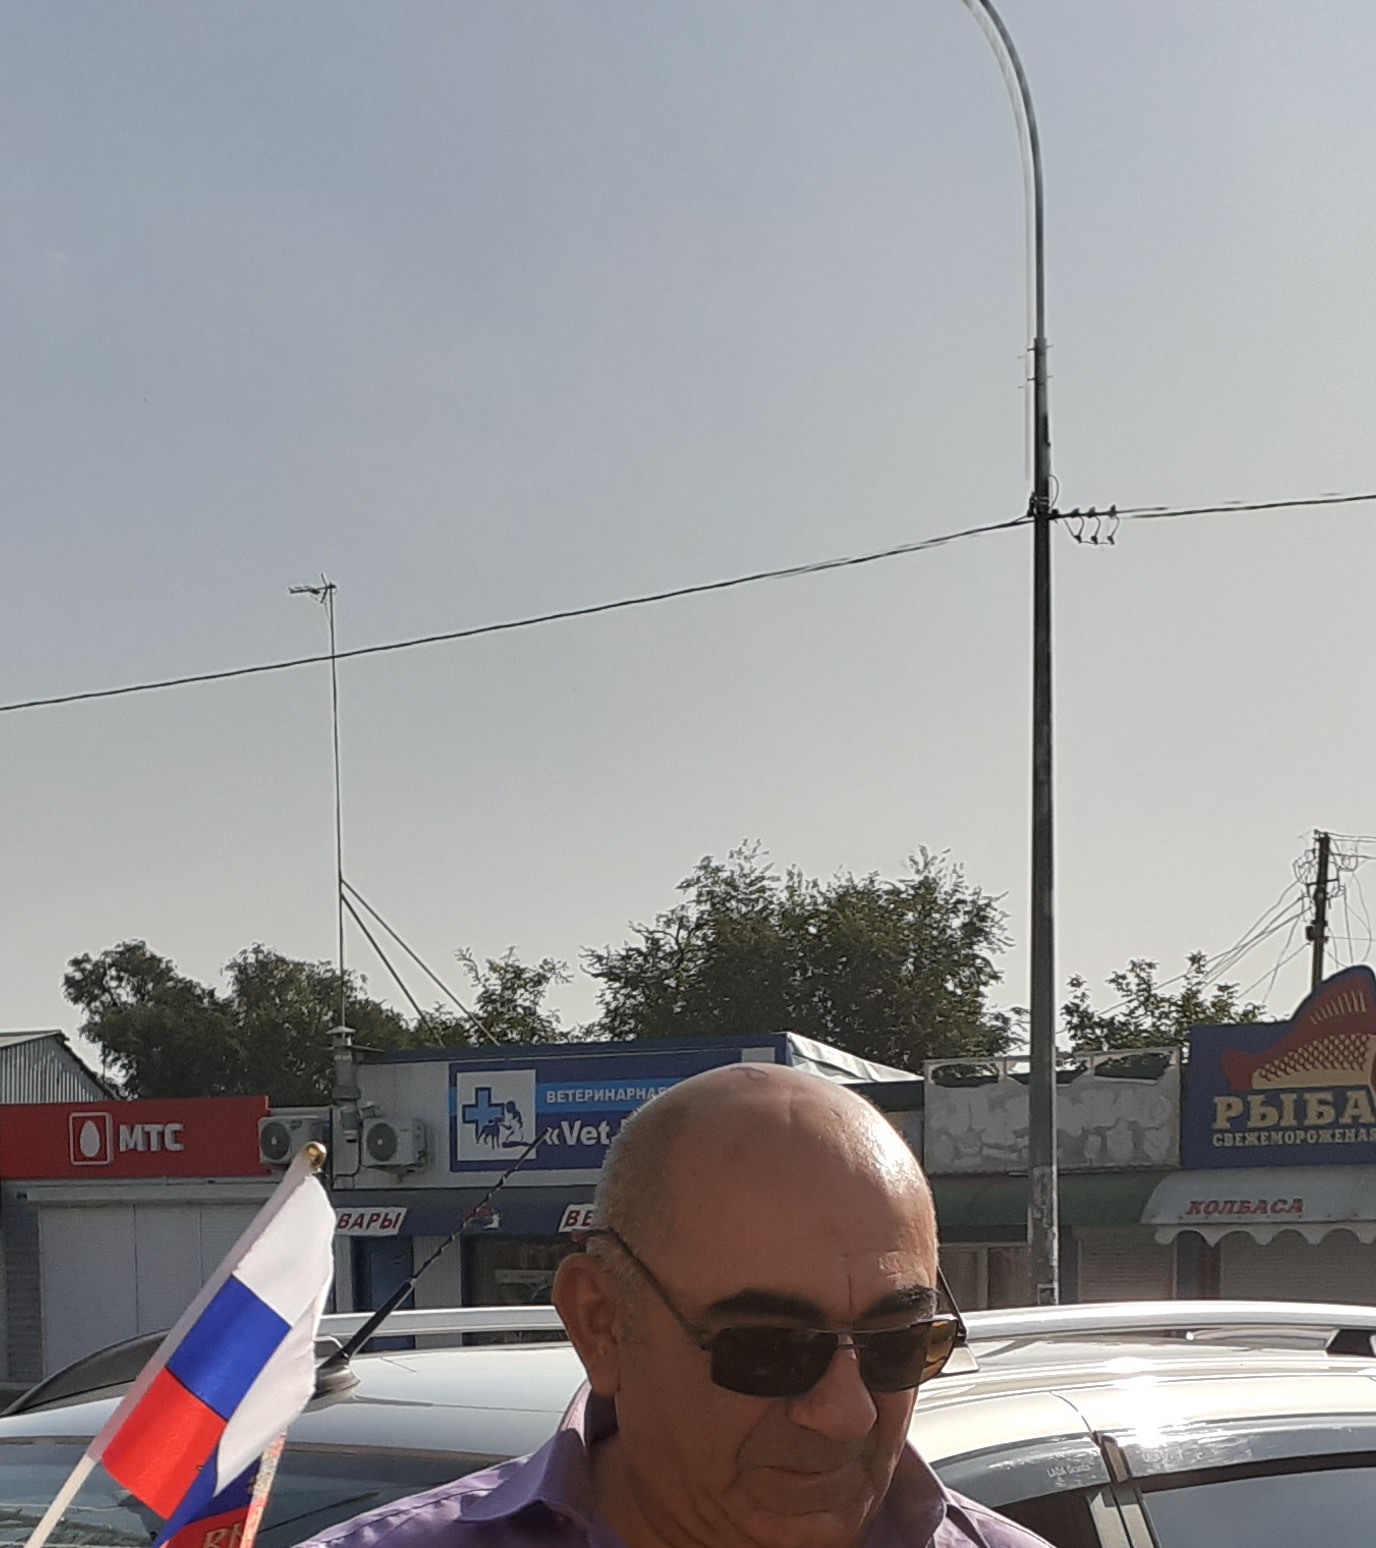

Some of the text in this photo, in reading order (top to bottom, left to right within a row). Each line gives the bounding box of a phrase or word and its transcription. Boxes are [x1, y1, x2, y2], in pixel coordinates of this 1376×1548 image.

[1212, 1090, 1376, 1129] РЫБА
[119, 1122, 185, 1153] МТС
[1185, 1198, 1304, 1215] КОЛБАСА
[336, 1212, 402, 1230] ВАРЫ
